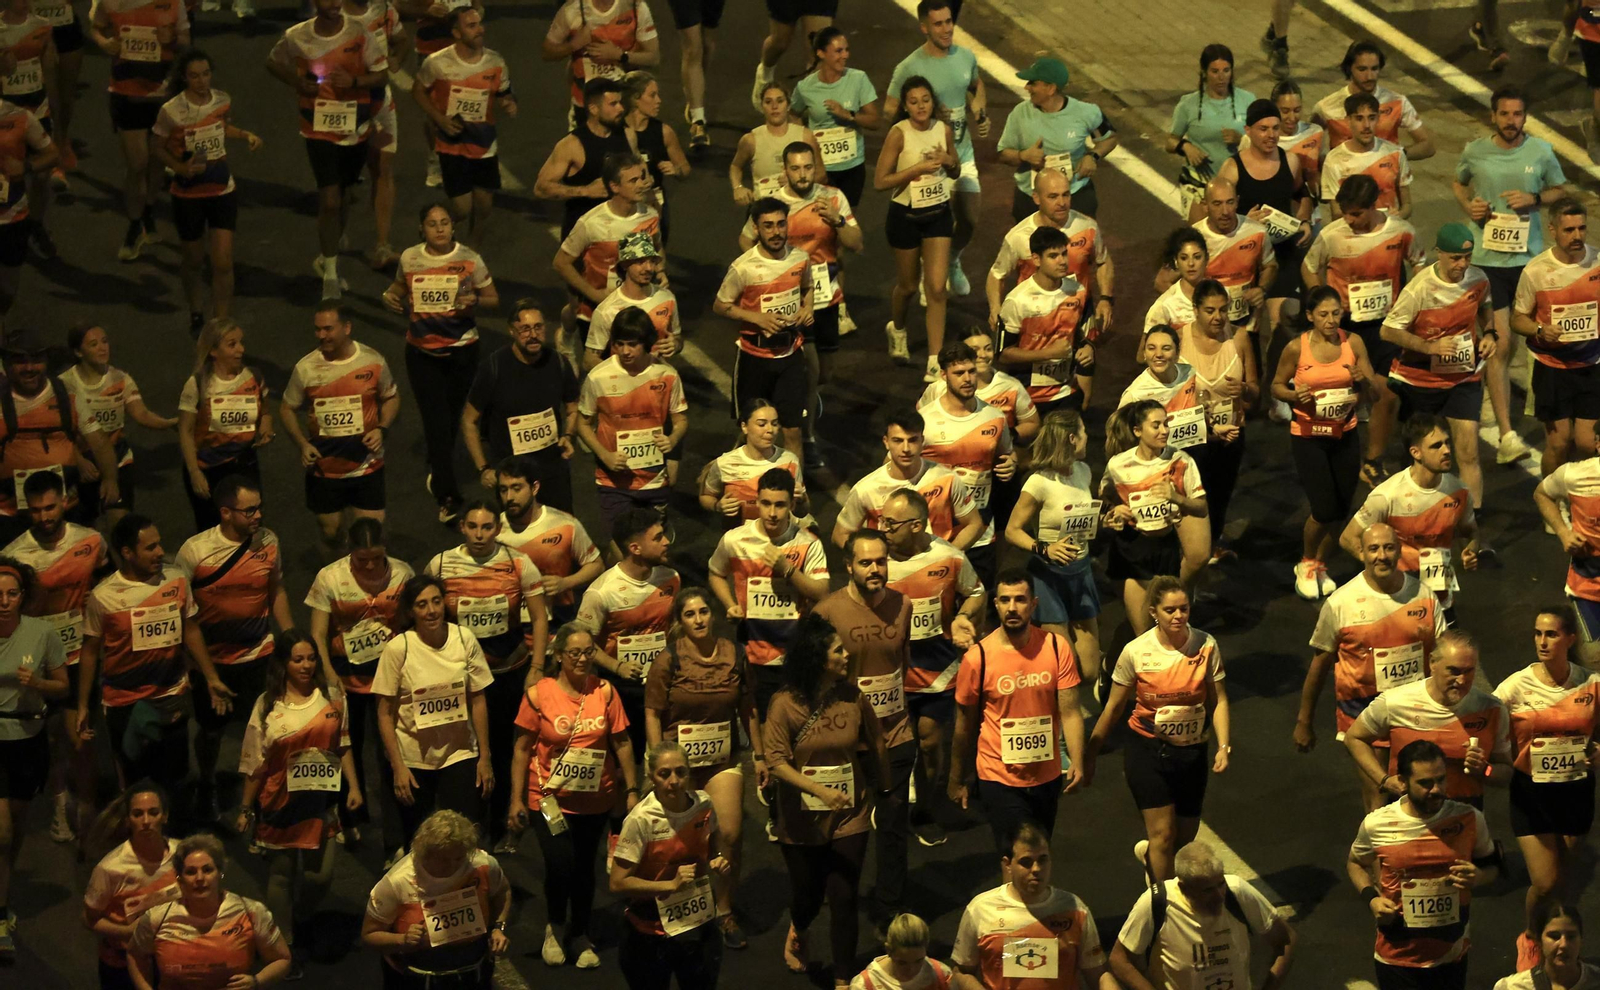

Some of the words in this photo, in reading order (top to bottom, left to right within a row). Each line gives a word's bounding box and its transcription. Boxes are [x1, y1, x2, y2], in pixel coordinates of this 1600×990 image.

[124, 39, 157, 52] 12019
[7, 71, 37, 86] 24716
[456, 100, 481, 113] 7882
[322, 114, 347, 126] 7881
[194, 138, 220, 151] 6630
[823, 140, 849, 154] 3396
[919, 184, 943, 199] 1948
[1492, 228, 1520, 241] 8674
[421, 291, 449, 303] 6626
[1356, 295, 1388, 311] 14873
[1557, 317, 1592, 332] 10607
[95, 410, 117, 423] 505
[220, 411, 248, 424] 6506
[324, 412, 354, 426] 6522
[516, 425, 552, 443] 16603
[1172, 423, 1198, 440] 4549
[623, 444, 657, 459] 20377
[1138, 501, 1173, 520] 14267
[1066, 516, 1094, 531] 14461
[753, 593, 791, 607] 17053
[464, 612, 502, 627] 19672
[912, 614, 935, 628] 061
[138, 621, 177, 638] 19674
[849, 623, 897, 643] GIRO
[350, 629, 388, 653] 21433
[1382, 661, 1419, 680] 14373
[1016, 671, 1052, 689] GIRO
[419, 697, 459, 715] 20094
[1161, 722, 1198, 737] 22013
[684, 740, 723, 756] 23237
[1007, 734, 1047, 750] 19699
[1541, 755, 1576, 770] 6244
[293, 765, 335, 778] 20986
[555, 762, 596, 780] 20985
[665, 896, 707, 923] 23586
[1409, 896, 1453, 914] 11269
[432, 907, 476, 932] 23578
